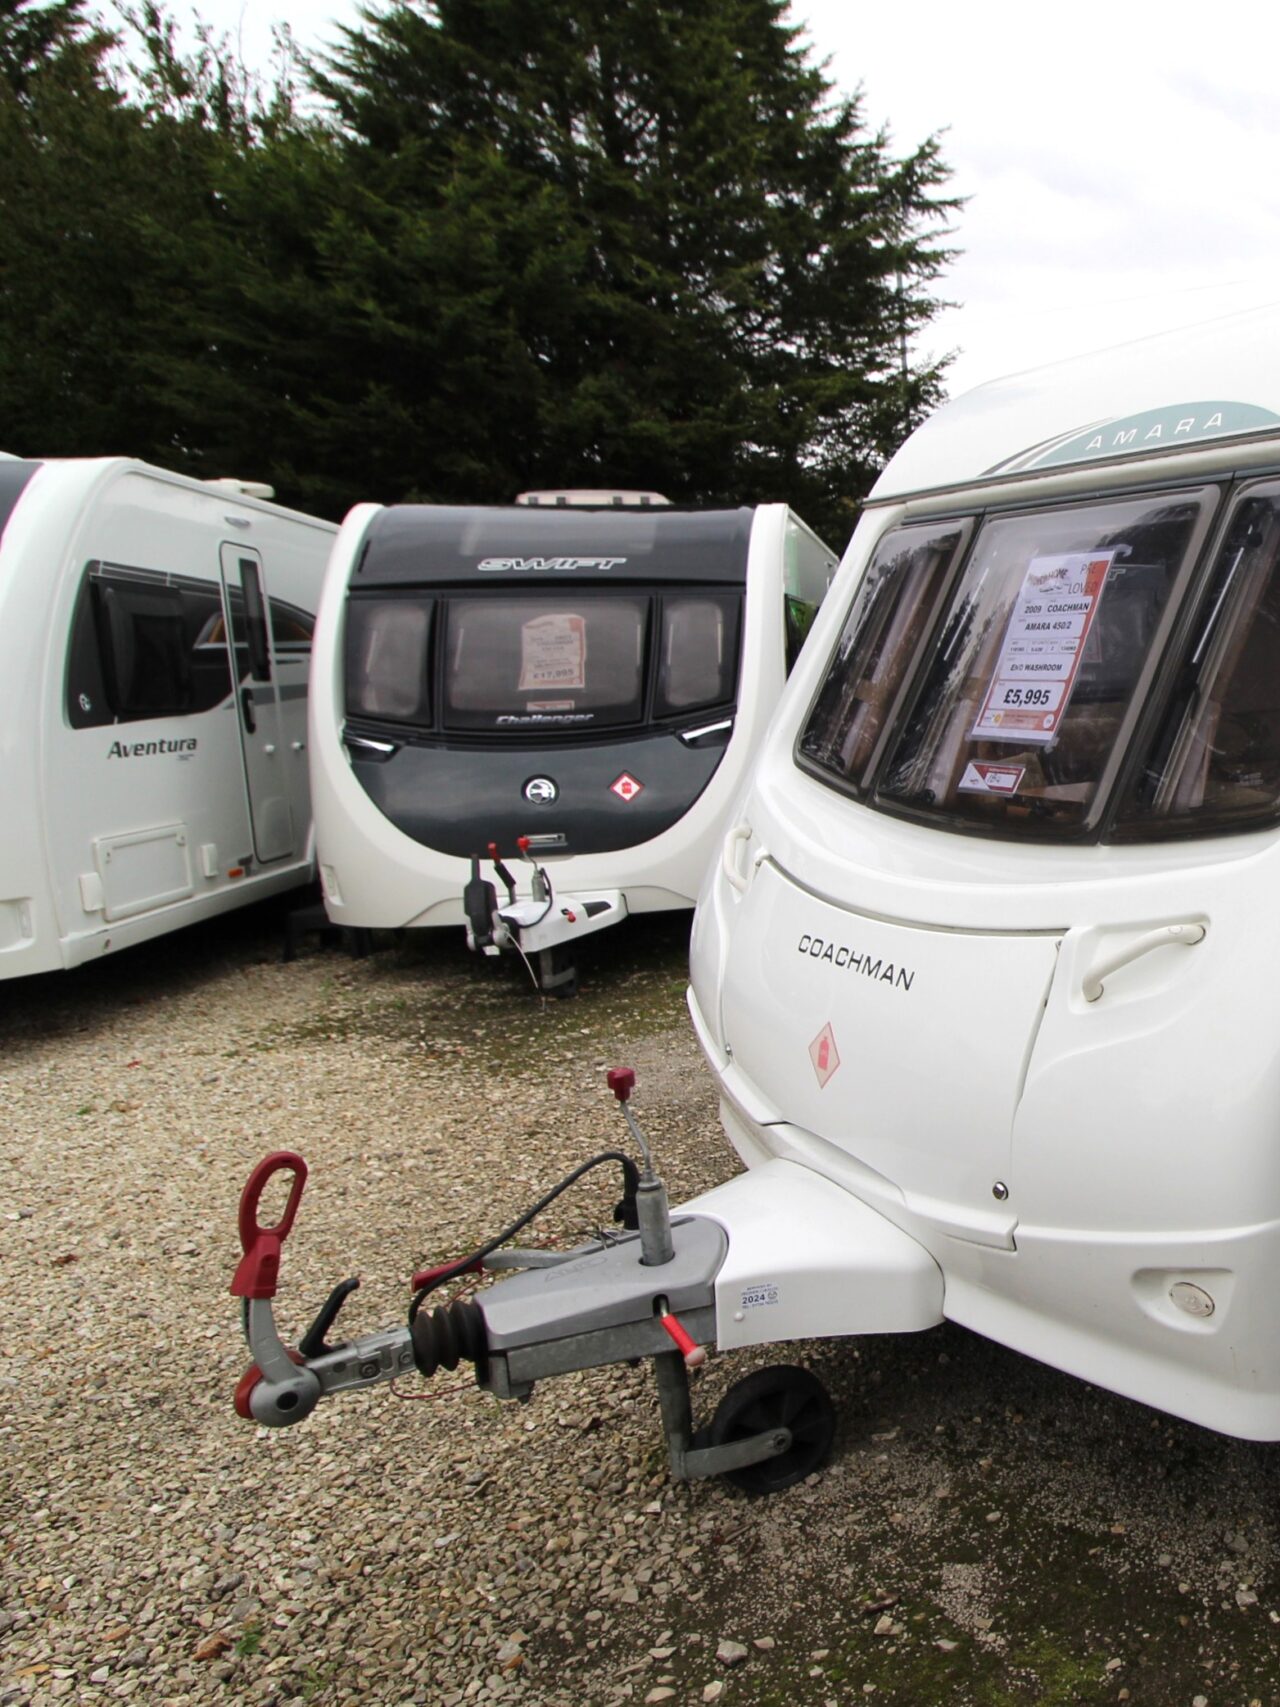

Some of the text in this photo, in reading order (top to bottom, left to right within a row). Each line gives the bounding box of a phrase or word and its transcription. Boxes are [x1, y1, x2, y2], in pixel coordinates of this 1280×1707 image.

[1085, 412, 1222, 450] AMARA
[478, 557, 627, 571] SWIFT
[1024, 602, 1089, 614] 2009 COACHMAN
[1024, 621, 1051, 631] AMARA
[1025, 663, 1063, 672] WASHROOM
[1003, 688, 1051, 708] £5,995
[496, 714, 594, 725] Challenger
[107, 738, 198, 759] Aventura
[798, 934, 915, 991] COACHMAN
[742, 1293, 766, 1305] 2024
